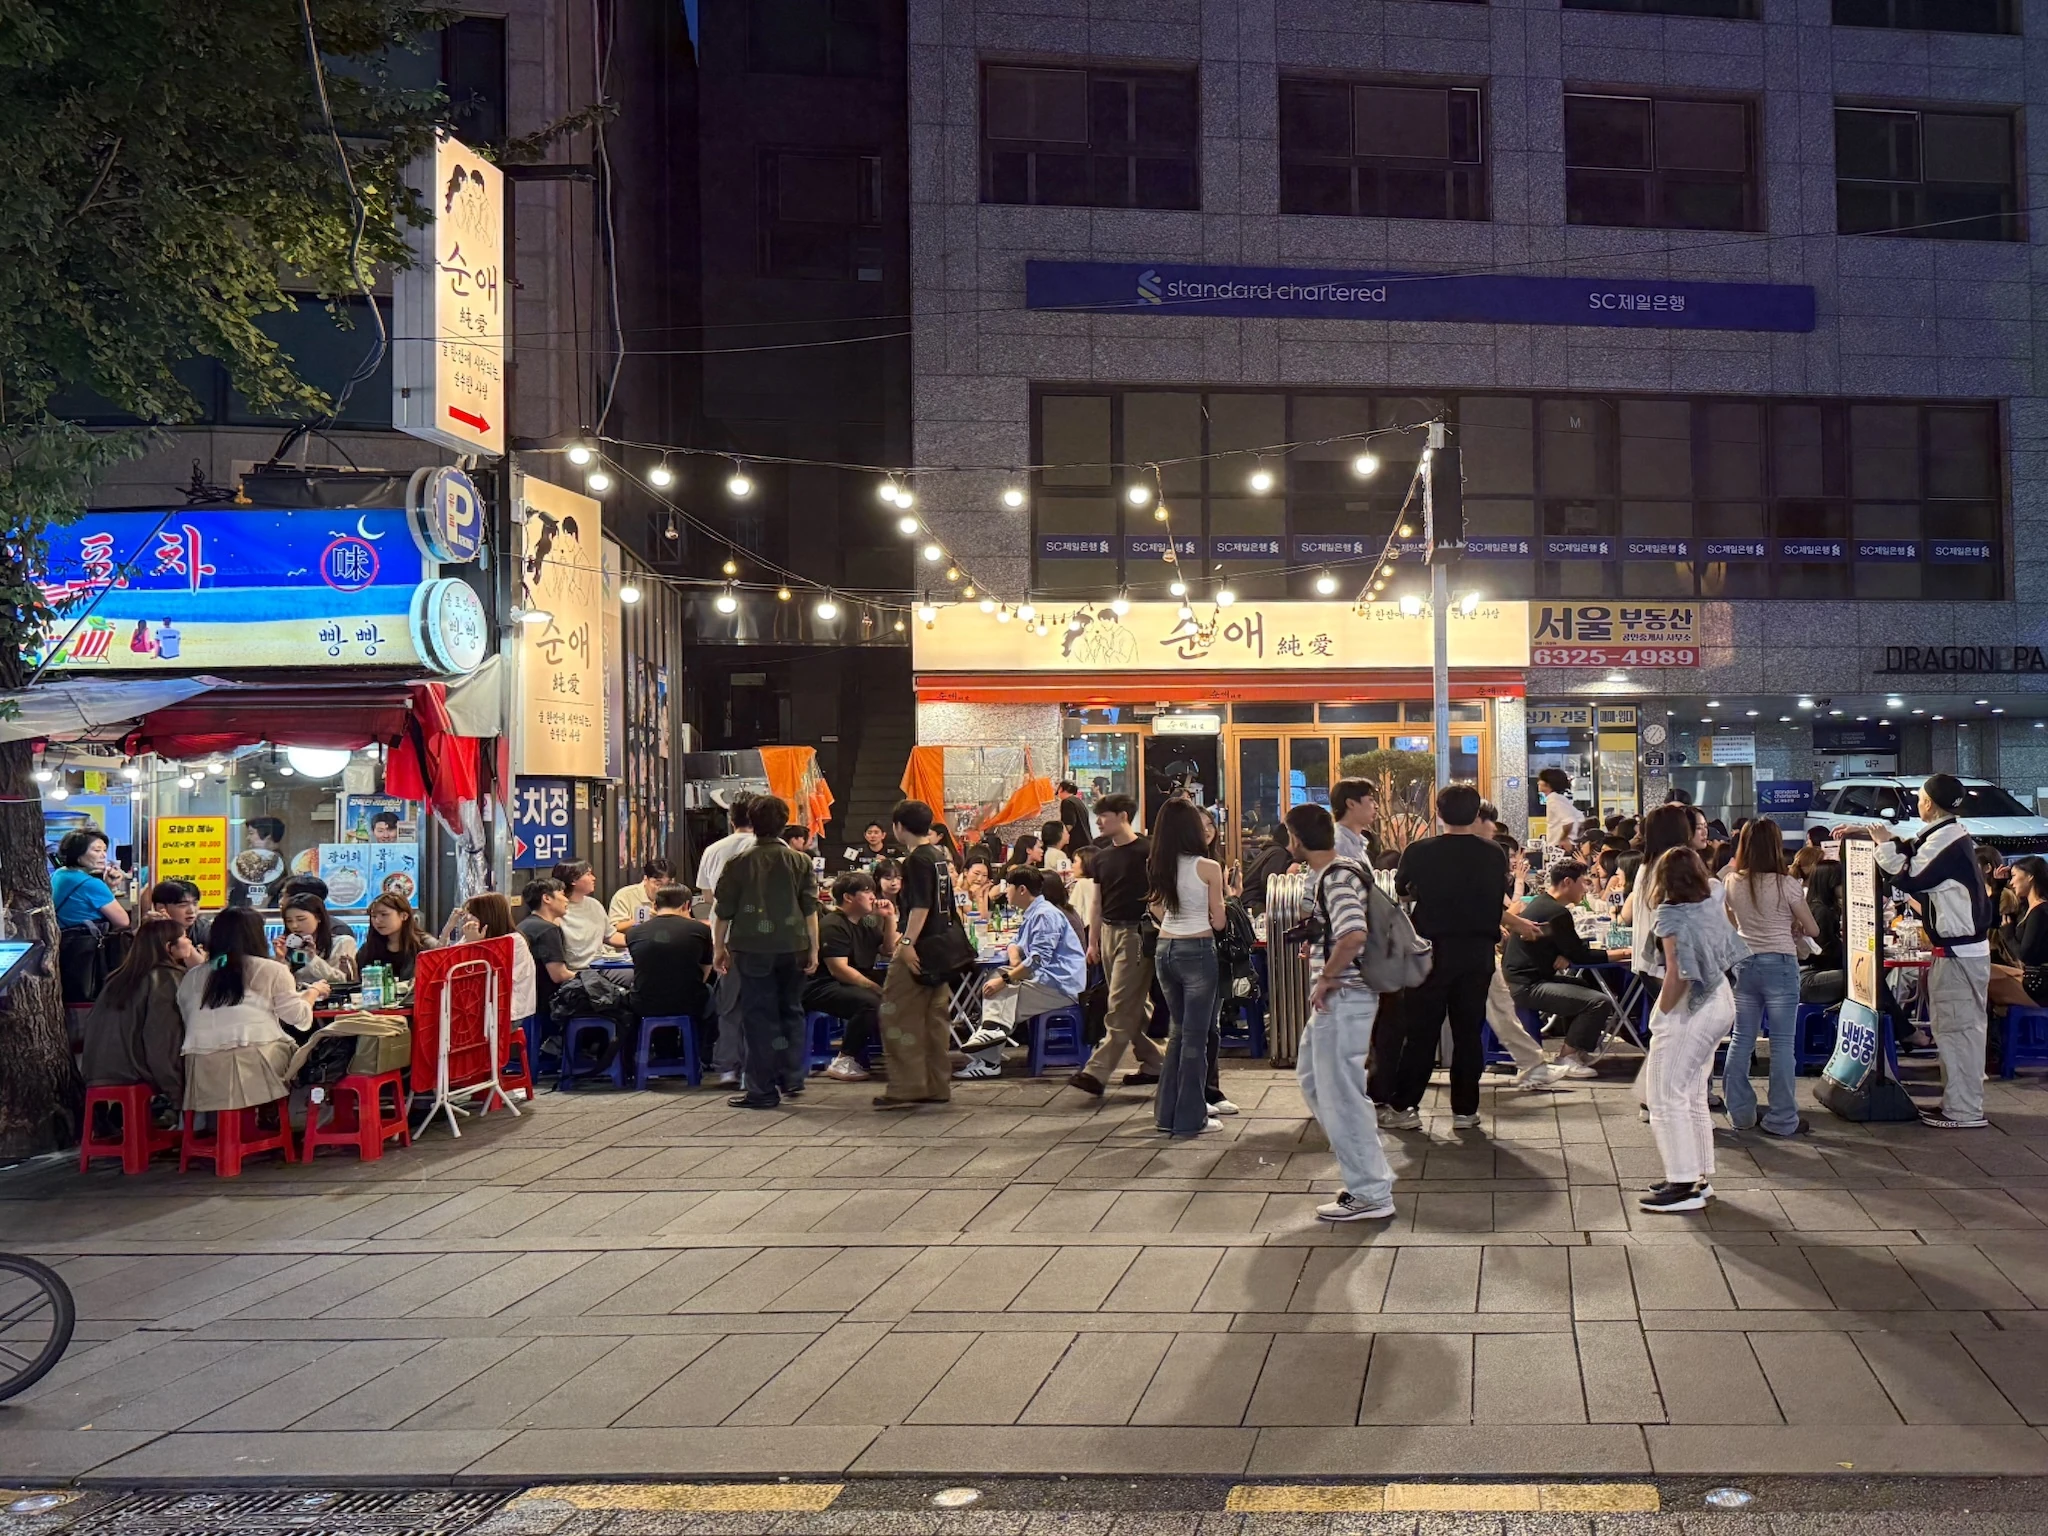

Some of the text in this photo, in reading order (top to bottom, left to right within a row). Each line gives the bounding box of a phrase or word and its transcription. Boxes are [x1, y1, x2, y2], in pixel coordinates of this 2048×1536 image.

[436, 242, 497, 315] 순애
[1167, 280, 1387, 302] standard chartered
[1589, 293, 1685, 312] SC제일은행
[446, 478, 474, 544] P
[1132, 543, 1182, 553] SC제일행
[1217, 542, 1268, 552] SC제일은행
[1302, 543, 1352, 553] SC제일은행
[1468, 543, 1517, 552] SC제일은행
[1549, 543, 1597, 553] SC제일은행
[1629, 544, 1677, 554] SC제일은행
[1707, 544, 1754, 554] SC제일은행
[332, 545, 370, 581] 味
[1160, 602, 1335, 659] 순애 純愛
[1534, 607, 1693, 641] 서울 부동산
[536, 618, 589, 669] 순애
[1622, 633, 1692, 642] 공인중개사 사무소
[1534, 649, 1694, 665] 6325-4989
[1886, 646, 1994, 670] DRAGON
[1864, 759, 1879, 768] 입구
[534, 834, 567, 860] 입구
[955, 894, 966, 904] 12
[1609, 893, 1621, 905] 49
[639, 909, 645, 919] 6
[1841, 1019, 1876, 1066] 냉방중
